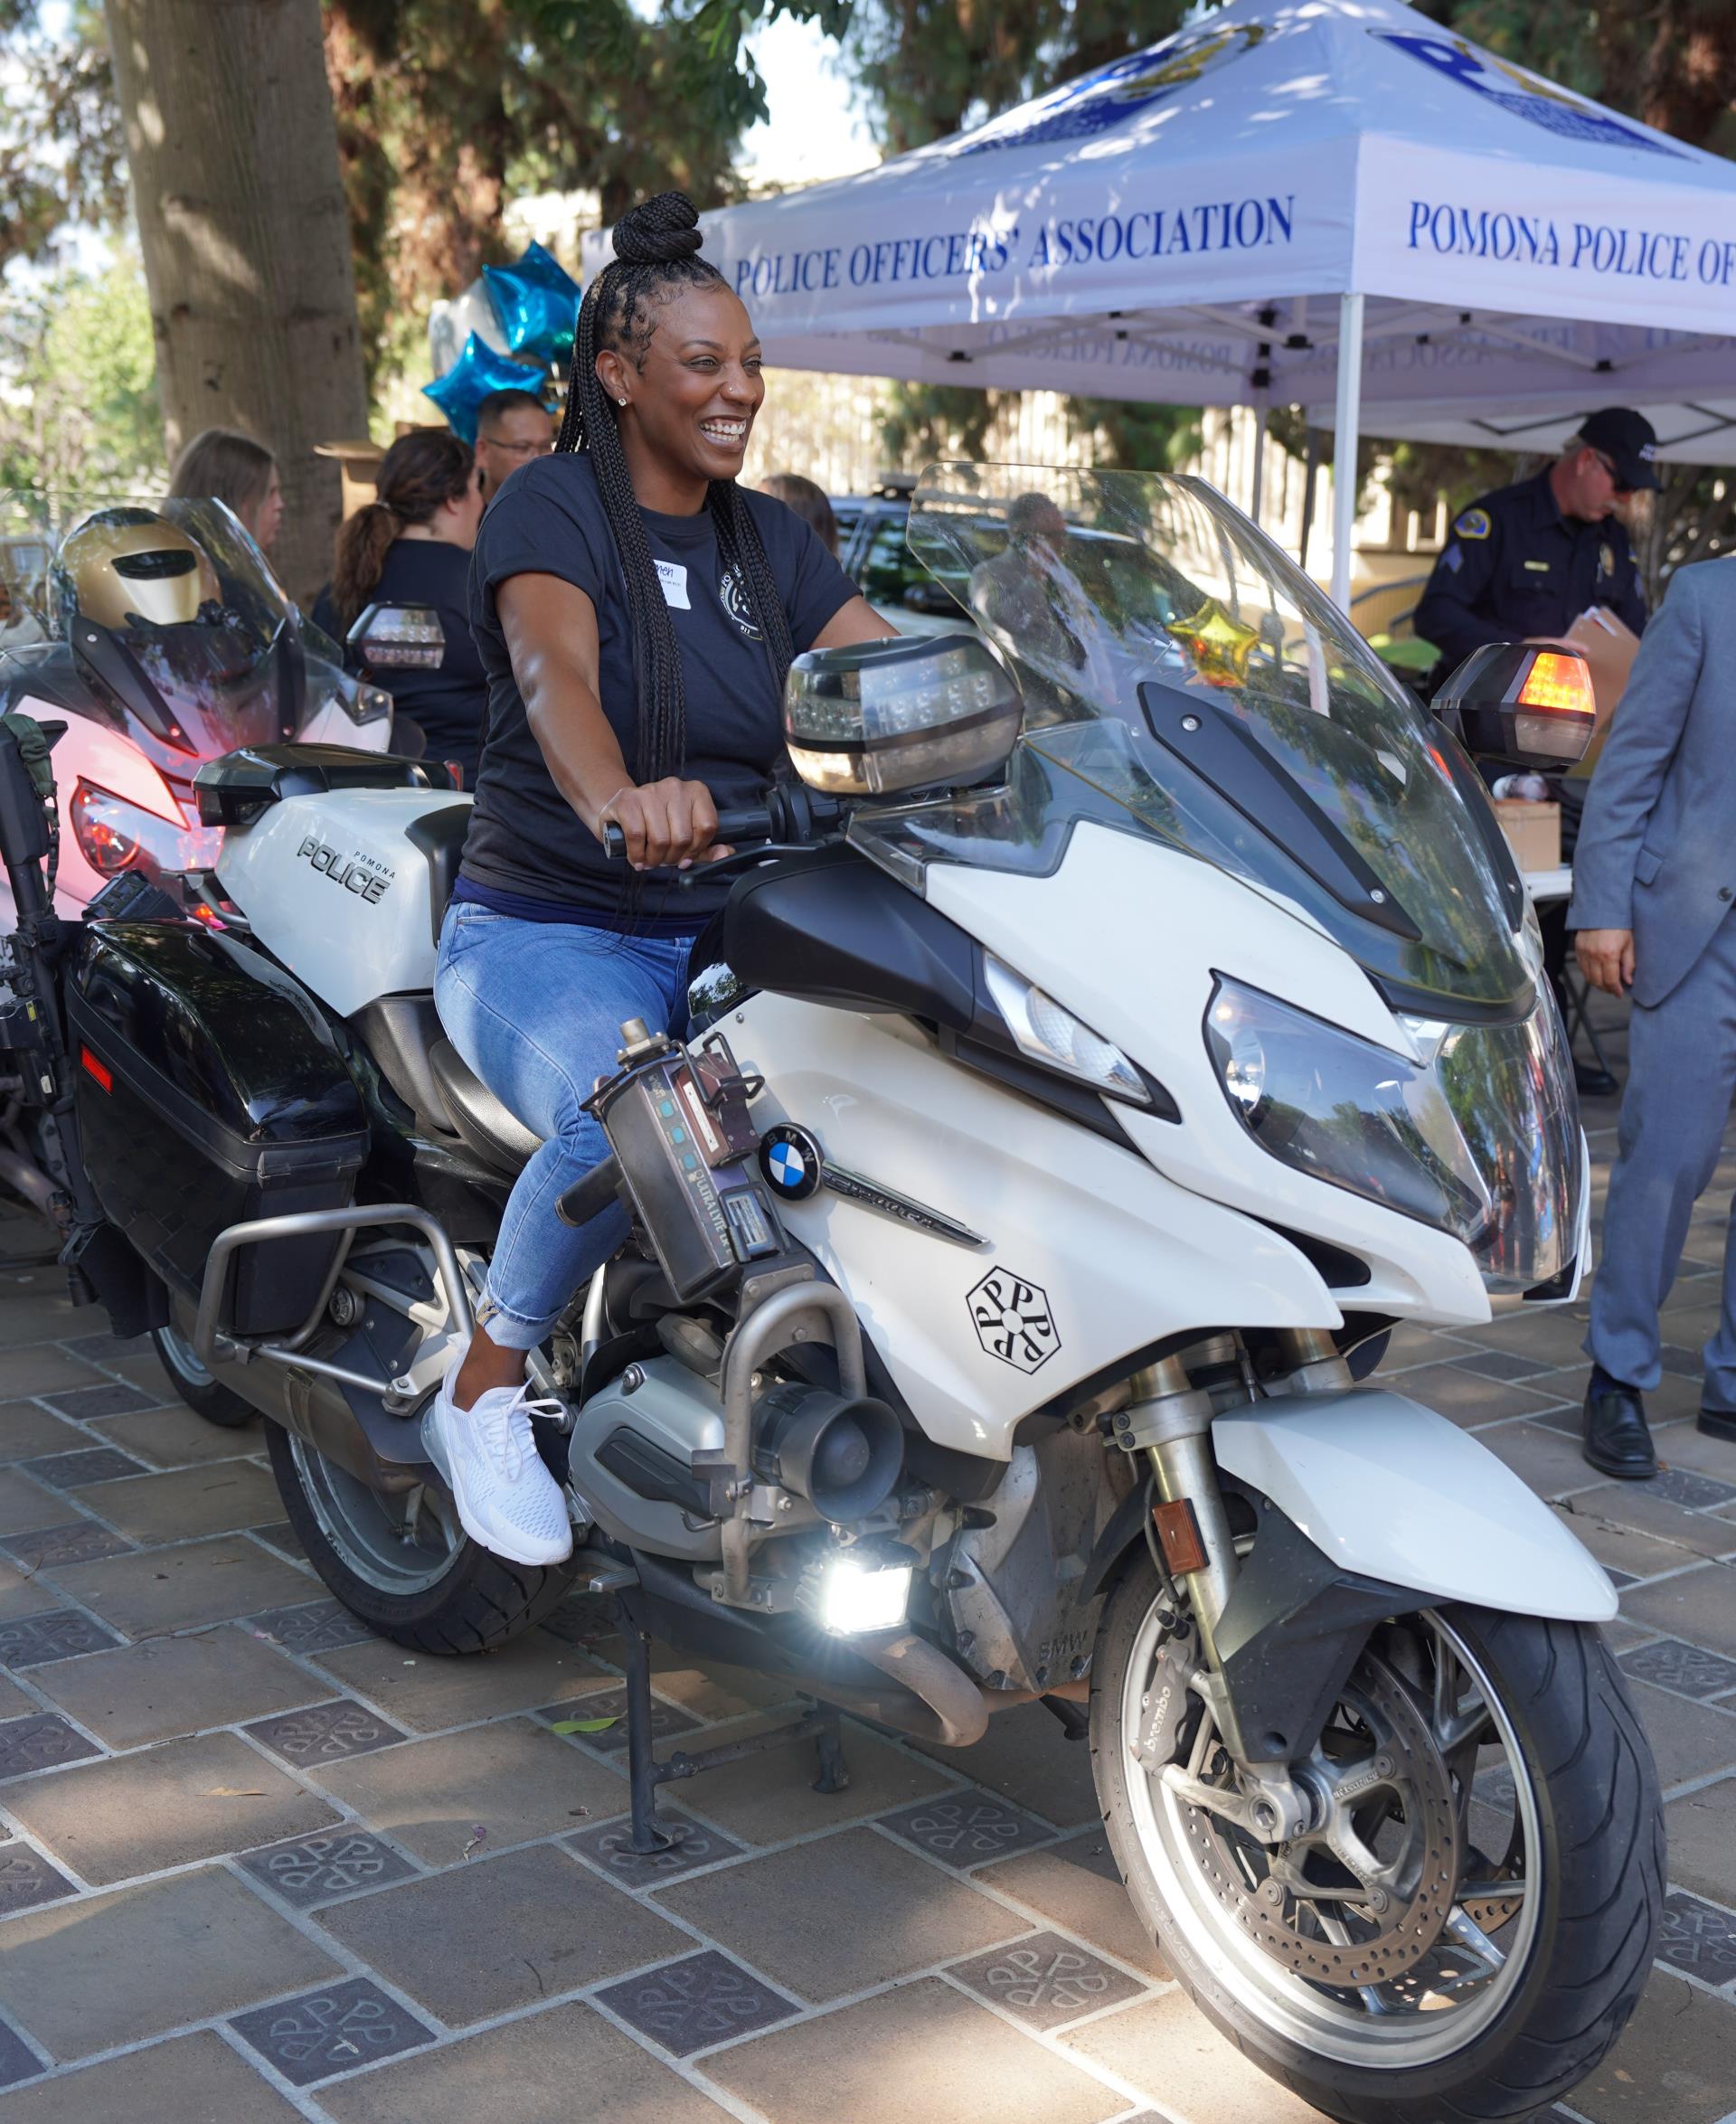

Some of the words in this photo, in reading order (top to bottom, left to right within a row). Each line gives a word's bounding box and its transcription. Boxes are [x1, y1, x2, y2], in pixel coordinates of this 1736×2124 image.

[736, 248, 842, 297] POLICE
[1027, 194, 1296, 269] ASSOCIATION
[1407, 200, 1560, 267] POMONA
[1570, 223, 1691, 281] POLICE
[297, 835, 391, 905] POLICE
[354, 851, 396, 879] POMONA
[768, 1129, 815, 1164] BMW
[696, 1179, 716, 1210] ULTRA
[709, 1207, 728, 1232] LYTE
[1143, 1685, 1172, 1752] brembo
